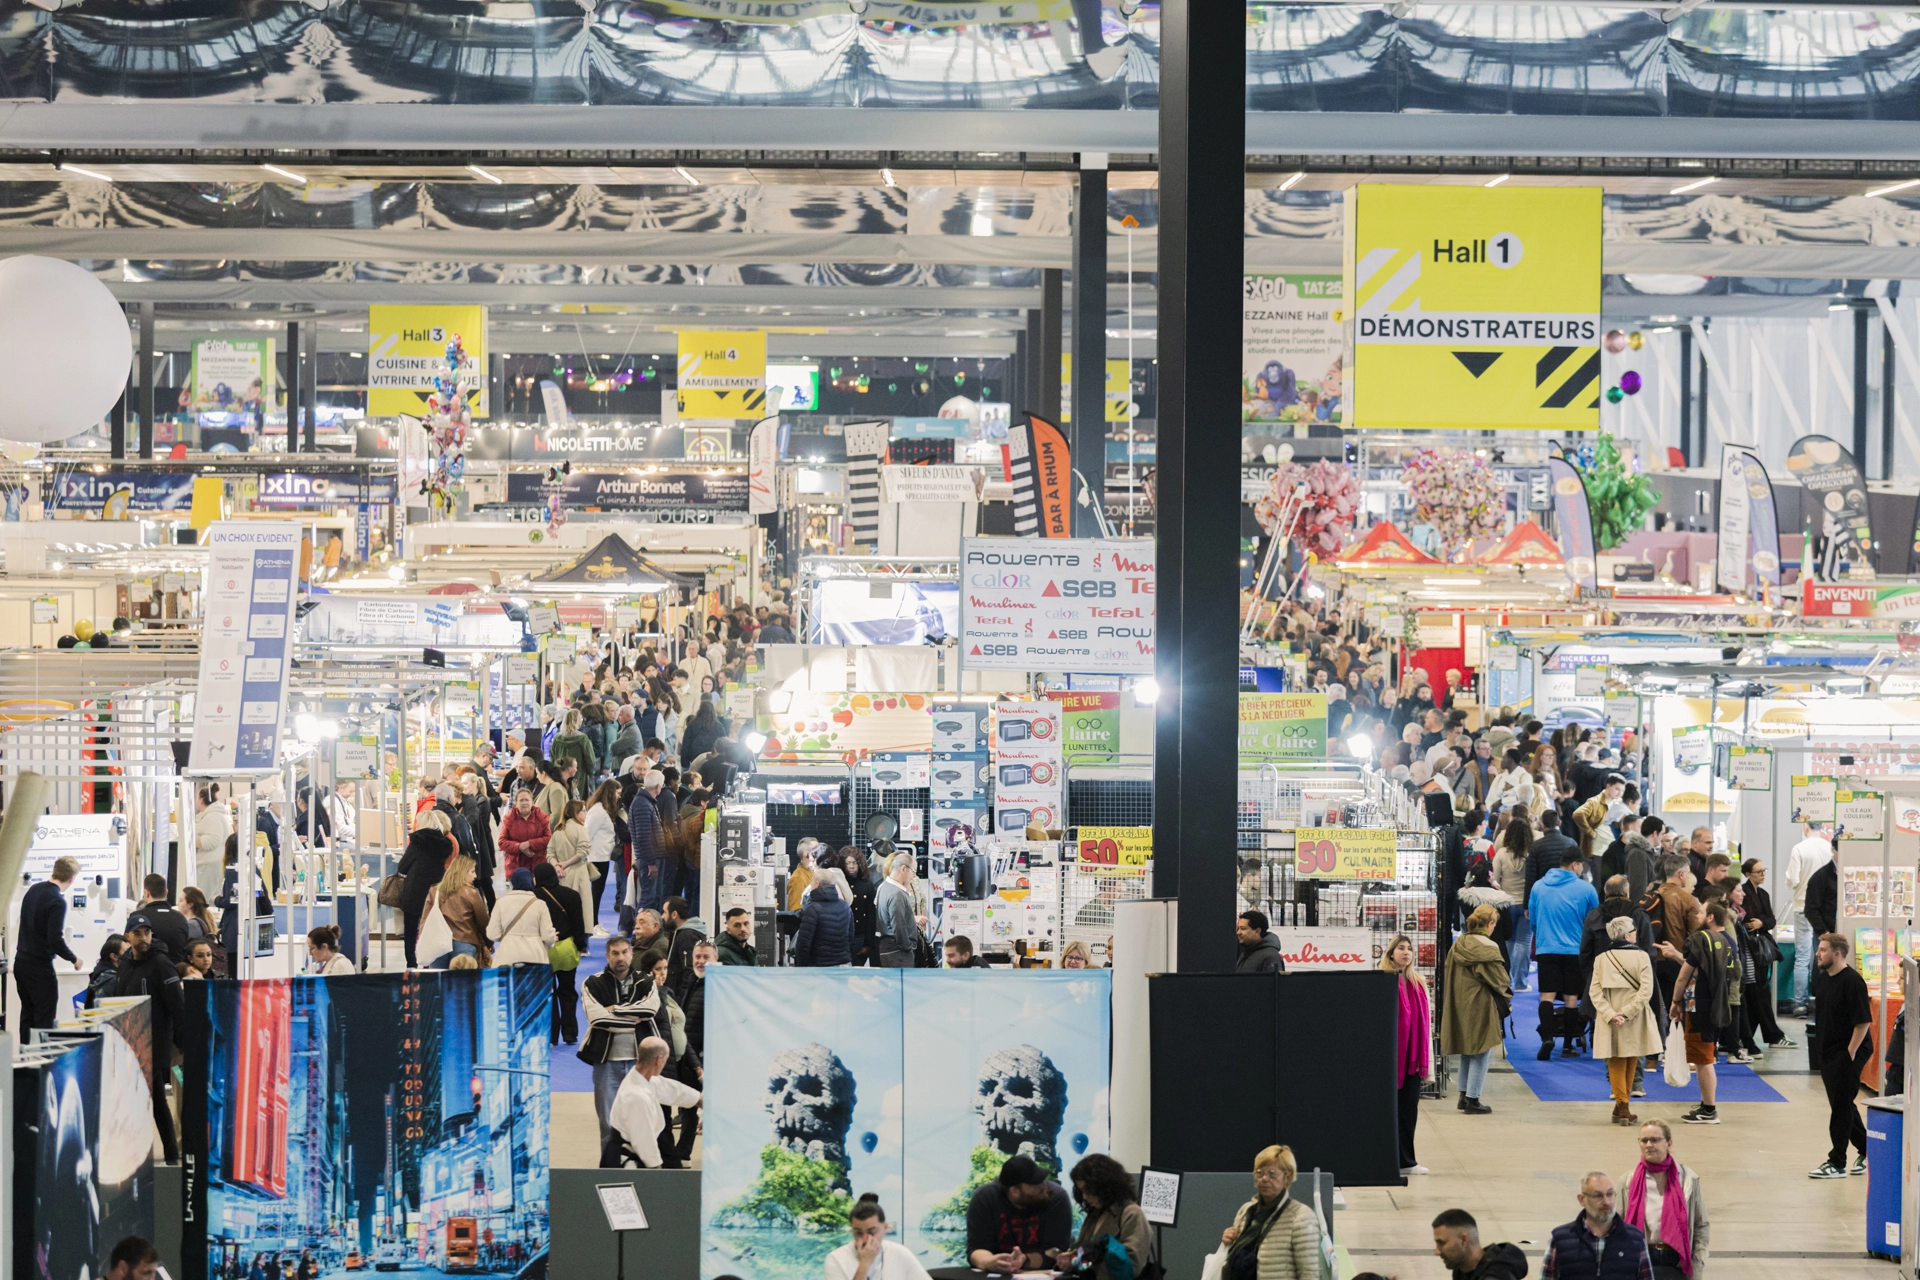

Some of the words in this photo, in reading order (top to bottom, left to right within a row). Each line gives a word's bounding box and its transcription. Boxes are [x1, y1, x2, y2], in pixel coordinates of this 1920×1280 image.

[1433, 239, 1486, 263] Hall
[1496, 238, 1509, 263] 1
[1303, 281, 1324, 295] TAT
[1244, 311, 1303, 320] EZZANINE
[1307, 311, 1328, 320] Hall
[1335, 312, 1342, 320] 7
[1252, 327, 1273, 335] Vivez
[1291, 327, 1325, 337] plongée
[1360, 314, 1595, 339] DÉMONSTRATEURS
[403, 329, 430, 342] Hall
[432, 328, 443, 342] 3
[1271, 337, 1290, 345] dans
[1328, 337, 1342, 345] des
[704, 350, 726, 360] Hall
[727, 349, 737, 360] 4
[1247, 347, 1276, 355] studios
[1278, 347, 1325, 355] d'animation
[376, 358, 427, 369] CUISINE
[371, 375, 418, 386] VITRINE
[684, 378, 759, 387] AMEUBLEMENT
[752, 434, 760, 466] CUISINES
[686, 454, 726, 462] MAISON
[1045, 441, 1057, 485] RHUM
[900, 467, 931, 479] SAVEURS
[933, 468, 965, 479] D'ANTAN
[259, 473, 330, 495] ixina
[596, 479, 640, 493] Arthur
[640, 480, 686, 494] Bonnet
[1531, 473, 1548, 504] XXL
[596, 495, 627, 504] Cuisine
[1045, 489, 1062, 500] À
[1052, 510, 1064, 535] BAR
[358, 511, 368, 549] ixina
[214, 533, 227, 543] UN
[227, 533, 255, 543] CHOIX
[967, 551, 1080, 566] Rowenta
[1125, 577, 1154, 594] Te
[969, 594, 1038, 609] Moulinex
[1814, 588, 1877, 601] ENVENUTI
[1884, 600, 1894, 612] in
[1903, 591, 1920, 608] Ita
[1087, 606, 1145, 619] Tefal
[974, 615, 1014, 625] Tefal
[1097, 626, 1154, 639] Row
[1560, 655, 1589, 663] NICKEL
[1590, 655, 1608, 663] CAR
[1081, 695, 1102, 707] VUE
[1246, 701, 1267, 711] BIEN
[997, 704, 1040, 714] Moulinex
[1249, 711, 1260, 721] LA
[1262, 708, 1305, 720] NÉGLIGER
[1241, 723, 1260, 736] La
[1261, 732, 1318, 749] Claire
[1068, 743, 1107, 751] LUNETTES
[997, 749, 1040, 760] Moulinex
[997, 794, 1040, 804] Moulinex
[48, 827, 101, 835] ATHENA
[1079, 828, 1108, 839] OFFRE
[1297, 829, 1326, 840] OFFRE
[1369, 830, 1395, 840] FOIRE
[1080, 837, 1118, 871] 50
[1134, 844, 1142, 852] les
[1352, 846, 1360, 854] les
[1373, 846, 1394, 854] affichés
[1297, 839, 1337, 874] 50
[1343, 856, 1393, 868] CULINAIRE
[1353, 868, 1394, 879] Tefal
[1280, 942, 1366, 964] ulinex
